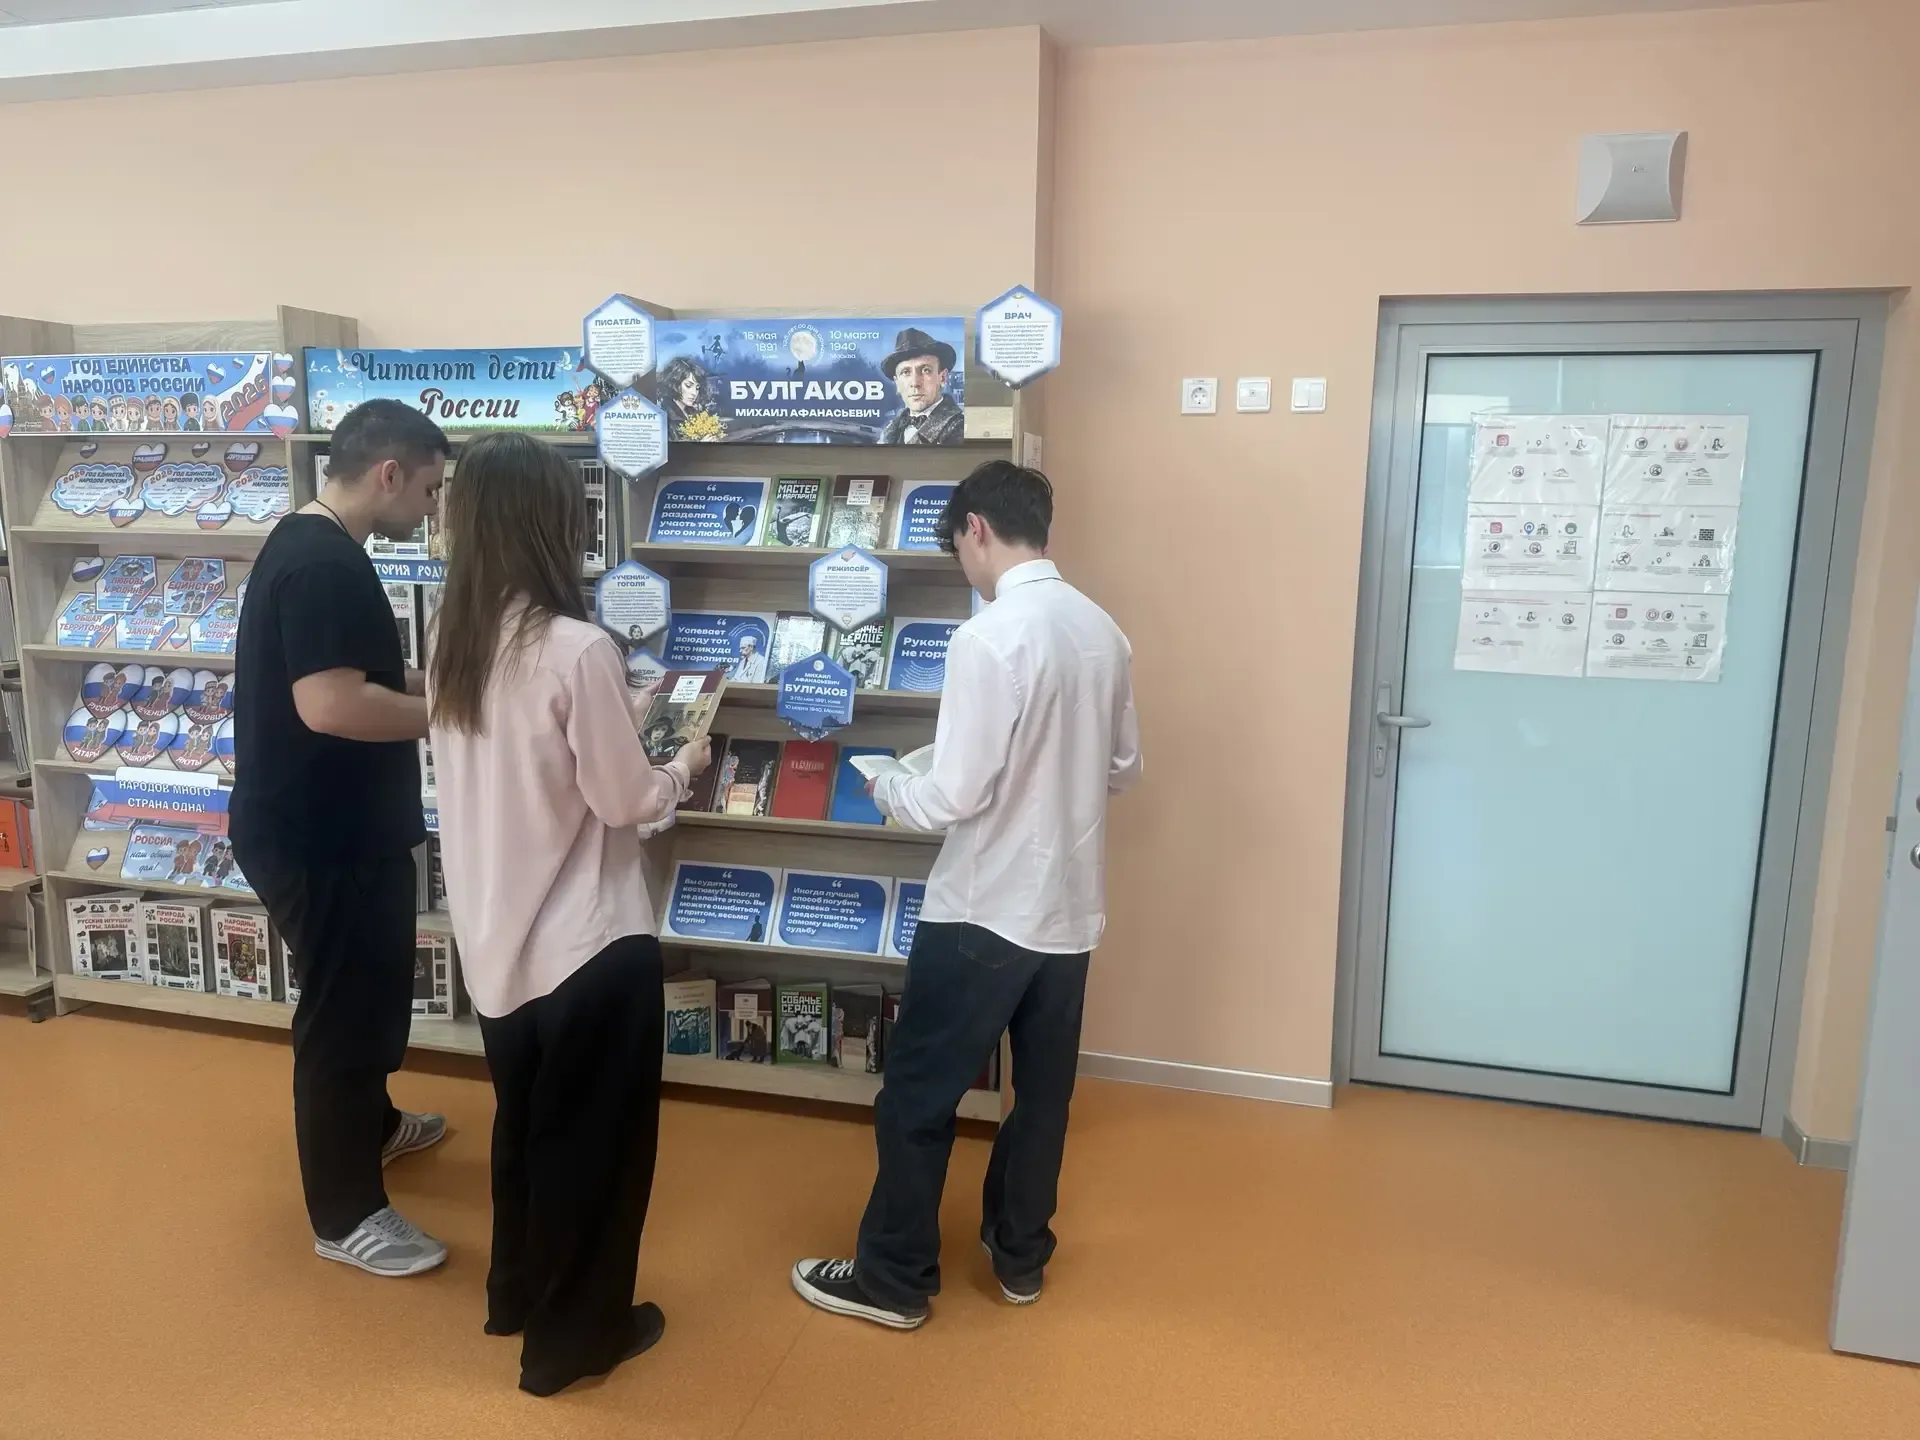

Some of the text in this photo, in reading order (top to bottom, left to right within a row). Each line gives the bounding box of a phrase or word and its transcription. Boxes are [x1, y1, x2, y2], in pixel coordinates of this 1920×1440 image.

[743, 332, 754, 340] 15
[829, 330, 880, 342] 10 марта
[755, 342, 778, 352] 1891
[830, 342, 857, 351] 1940
[71, 358, 192, 376] ГОД ЕДИНСТВА
[351, 351, 557, 381] Читают дети
[62, 377, 206, 394] НАРОДОВ РОССИИ
[730, 380, 885, 401] БУЛГАКОВ
[221, 374, 271, 420] 2026
[419, 387, 521, 419] России
[735, 408, 880, 418] МИХАИЛ АФАНАСЬЕВИЧ
[778, 484, 818, 494] МАСТЕР
[666, 493, 687, 502] Тот,
[660, 512, 718, 520] разделять
[373, 564, 410, 576] ТОРИЯ
[168, 581, 223, 592] ЕДИНСТВО
[130, 618, 166, 626] ЕДИНЫЕ
[60, 624, 112, 632] ТЕРРИТОРИЯ
[126, 628, 160, 636] ЗАКОНЫ
[678, 626, 726, 636] Успевает
[675, 636, 710, 645] всюду
[904, 636, 950, 648] Рукопи
[692, 646, 732, 654] никуда
[686, 656, 740, 664] торопится
[919, 651, 948, 660] горя
[794, 678, 840, 686] АФАНАСЬЕВИЧ
[785, 684, 848, 697] БУЛГАКОВ
[87, 702, 120, 713] РУССКИЕ
[72, 748, 100, 758] ТАТАРЫ
[121, 750, 155, 762] БАШКИРЫ
[176, 756, 203, 766] ЯКУТЫ
[119, 780, 211, 797] НАРОДОВ МНОГО
[128, 798, 205, 814] СТРАНА ОДНА!
[134, 835, 173, 846] РОССИЯ
[682, 886, 760, 898] костюму? Никогда
[793, 888, 860, 899] Иногда лучший
[692, 894, 726, 903] делайте
[792, 896, 862, 907] способ погубить
[712, 904, 760, 914] ошибиться,
[790, 904, 830, 912] человека
[684, 910, 717, 918] притом,
[788, 911, 848, 921] предоставить
[224, 918, 257, 928] НАРОДНЫЕ
[787, 918, 858, 930] самому выбрать
[786, 926, 816, 934] судьбу
[781, 995, 822, 1004] СОБАЧЬЕ
[781, 1004, 822, 1014] СЕРДЦЕ
